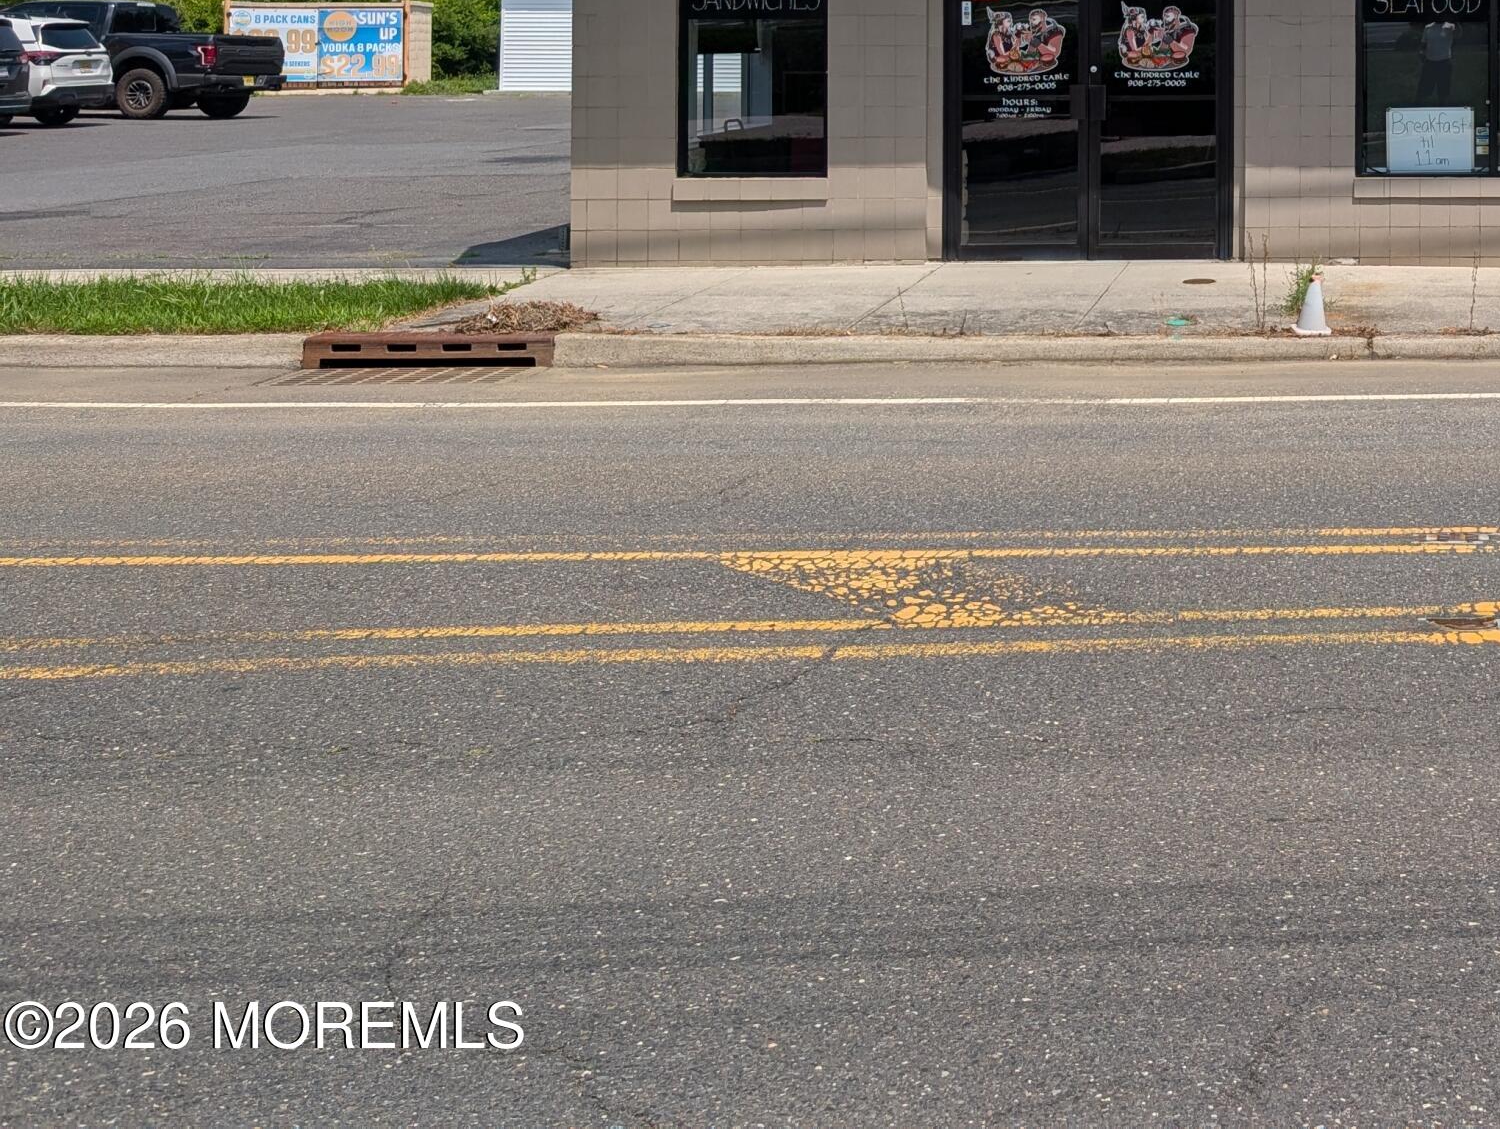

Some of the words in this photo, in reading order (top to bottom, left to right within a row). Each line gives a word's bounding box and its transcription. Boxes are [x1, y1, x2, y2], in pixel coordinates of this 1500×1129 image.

[255, 14, 260, 23] 8
[263, 14, 288, 24] PACK
[290, 14, 316, 24] CANS
[358, 11, 398, 25] SUN'S
[379, 27, 396, 40] UP
[322, 43, 355, 53] VODKA
[356, 43, 364, 52] 8
[366, 43, 401, 53] PACKS
[320, 54, 399, 77] $22.99
[1127, 79, 1187, 87] 908-275-0005
[1391, 111, 1468, 135] Breakfast
